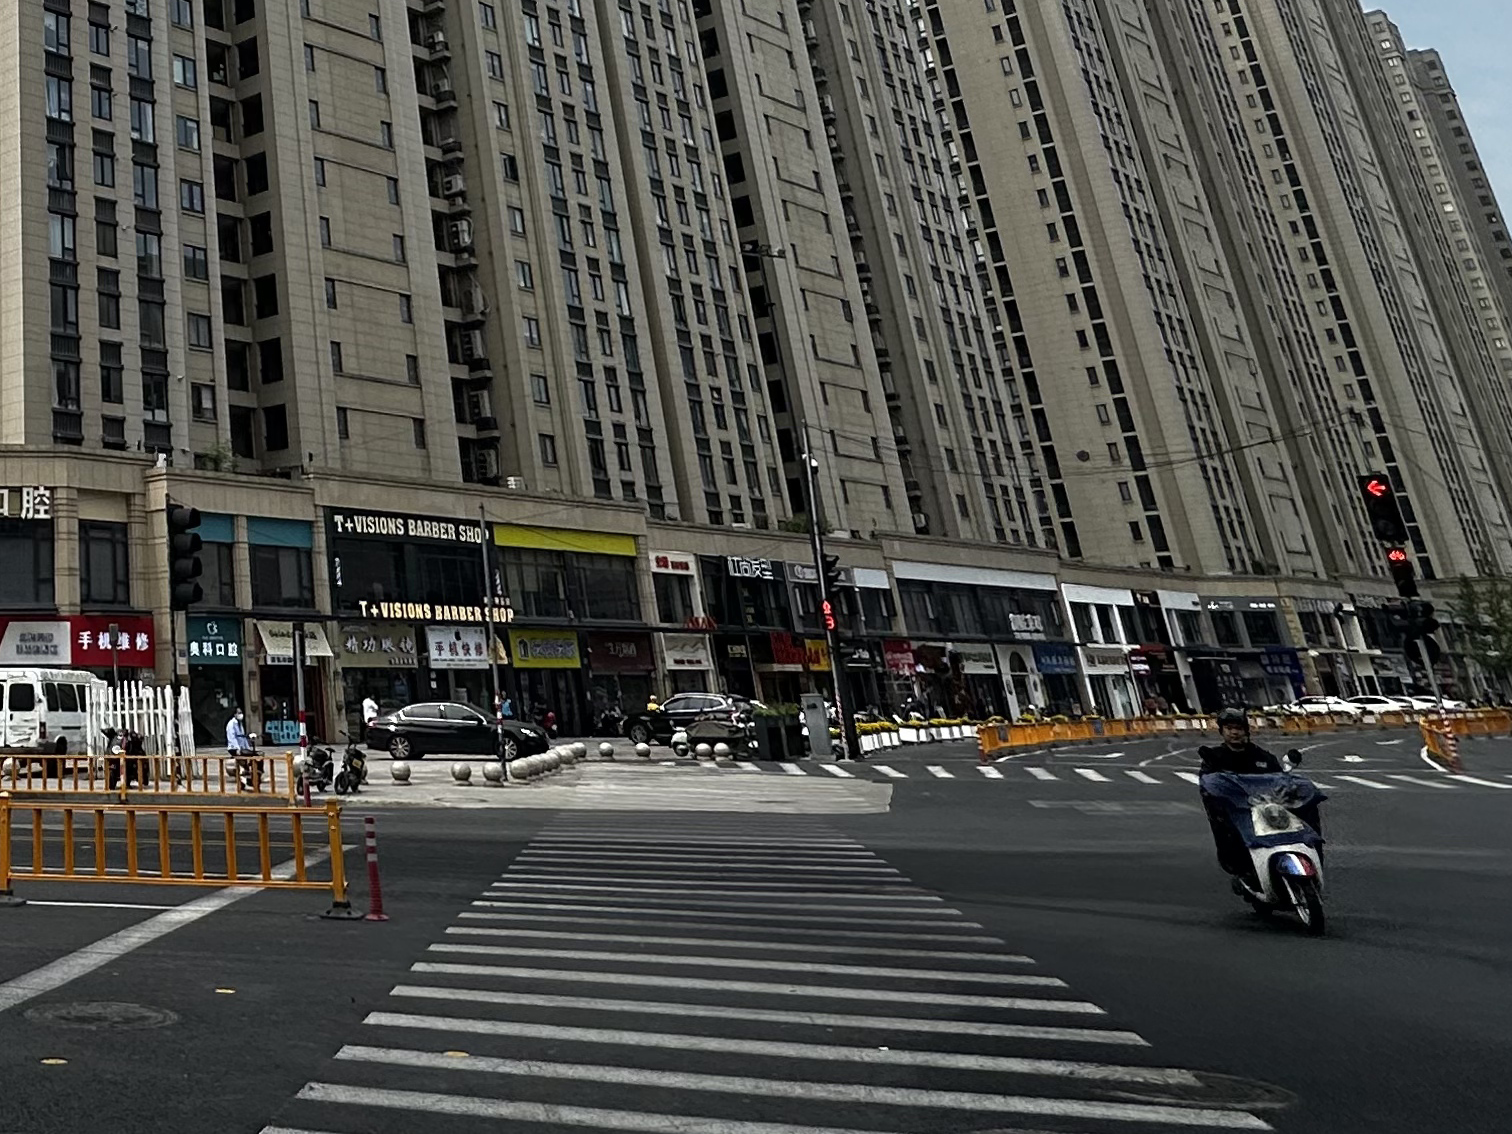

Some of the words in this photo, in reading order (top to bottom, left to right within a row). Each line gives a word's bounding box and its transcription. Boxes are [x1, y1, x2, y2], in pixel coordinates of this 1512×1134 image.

[334, 515, 405, 536] T+VISIONS
[407, 519, 456, 541] BARBER
[435, 605, 482, 621] BARBER
[78, 631, 149, 652] 手机维修
[189, 640, 238, 657] 奥科口腔
